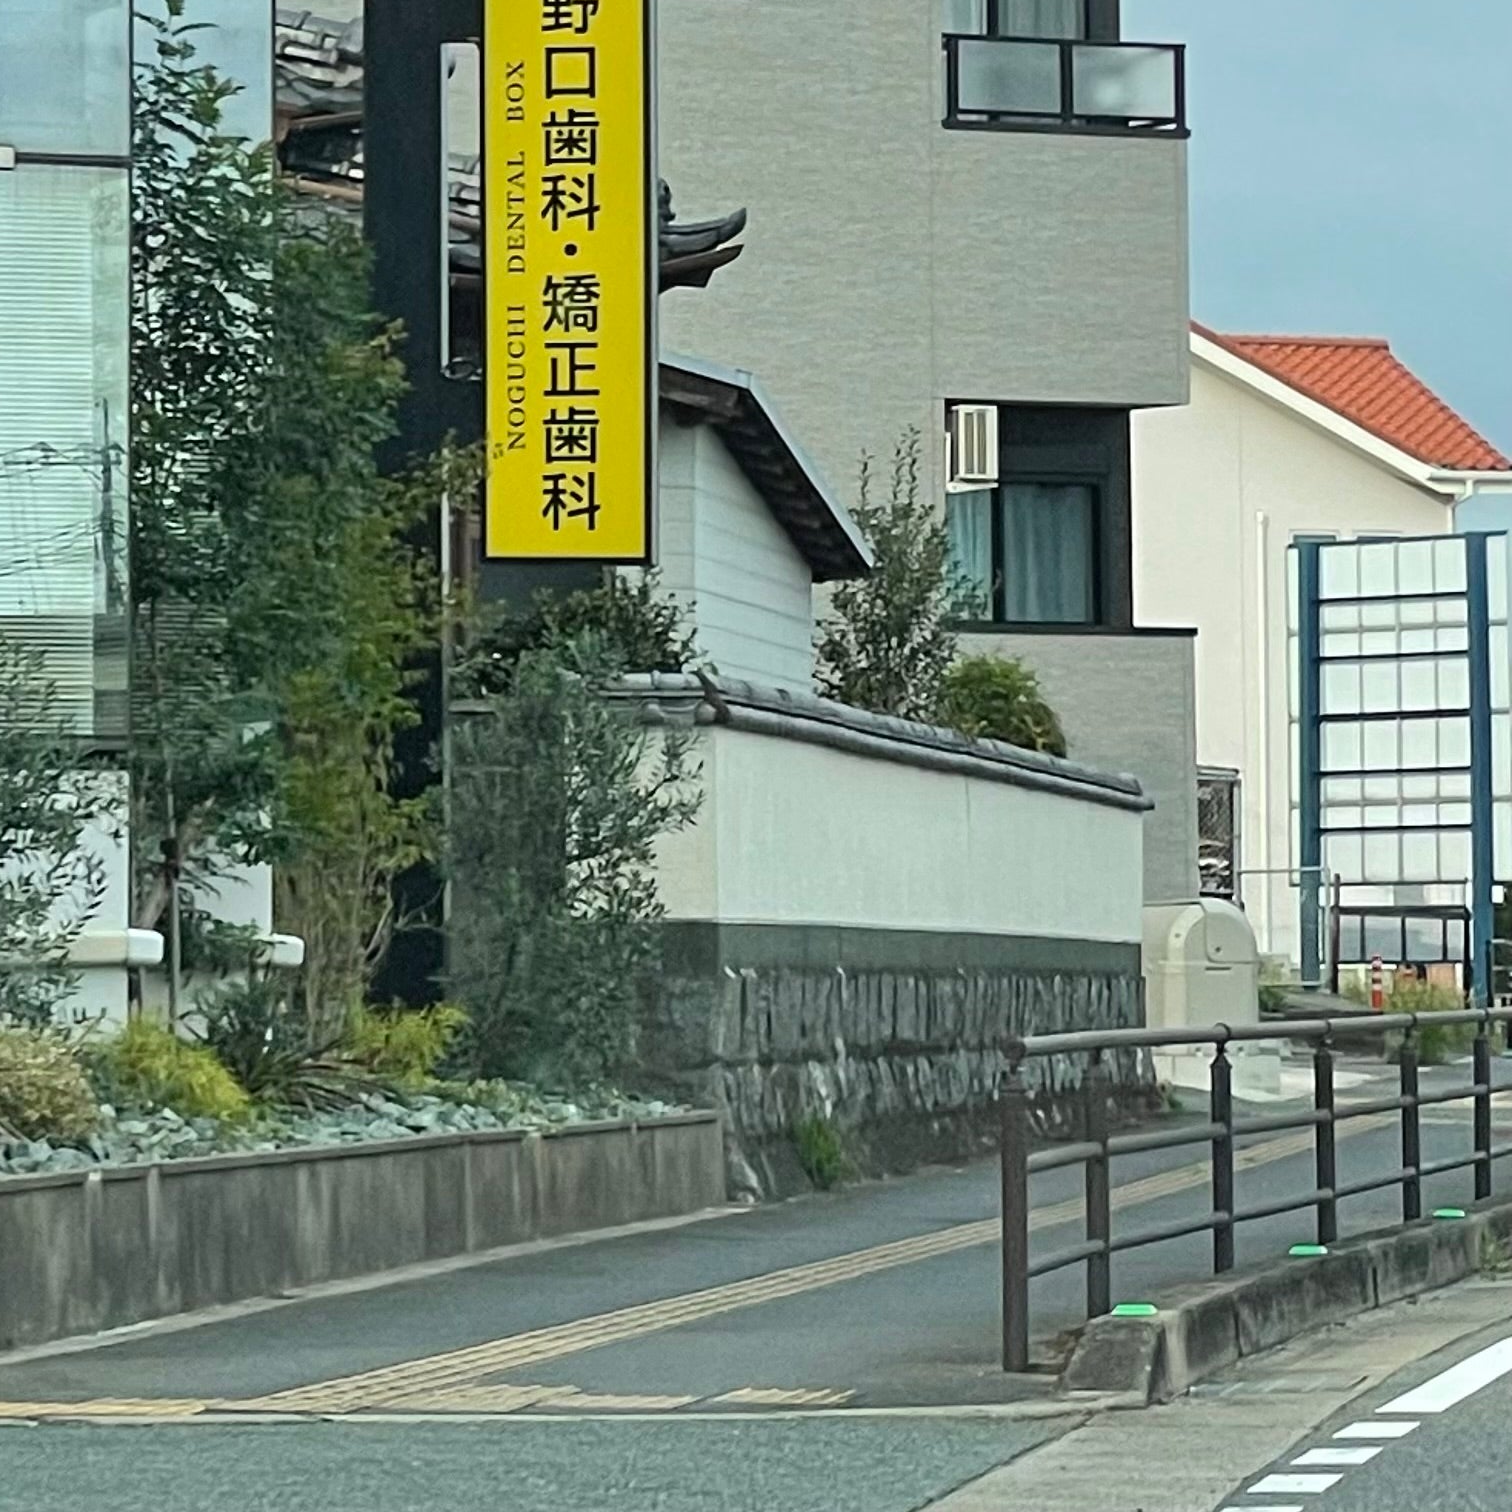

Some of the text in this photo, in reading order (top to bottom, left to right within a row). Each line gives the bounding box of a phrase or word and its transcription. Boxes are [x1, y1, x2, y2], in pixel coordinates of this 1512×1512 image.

[505, 60, 526, 451] NOGUCHI DENTAL BOX
